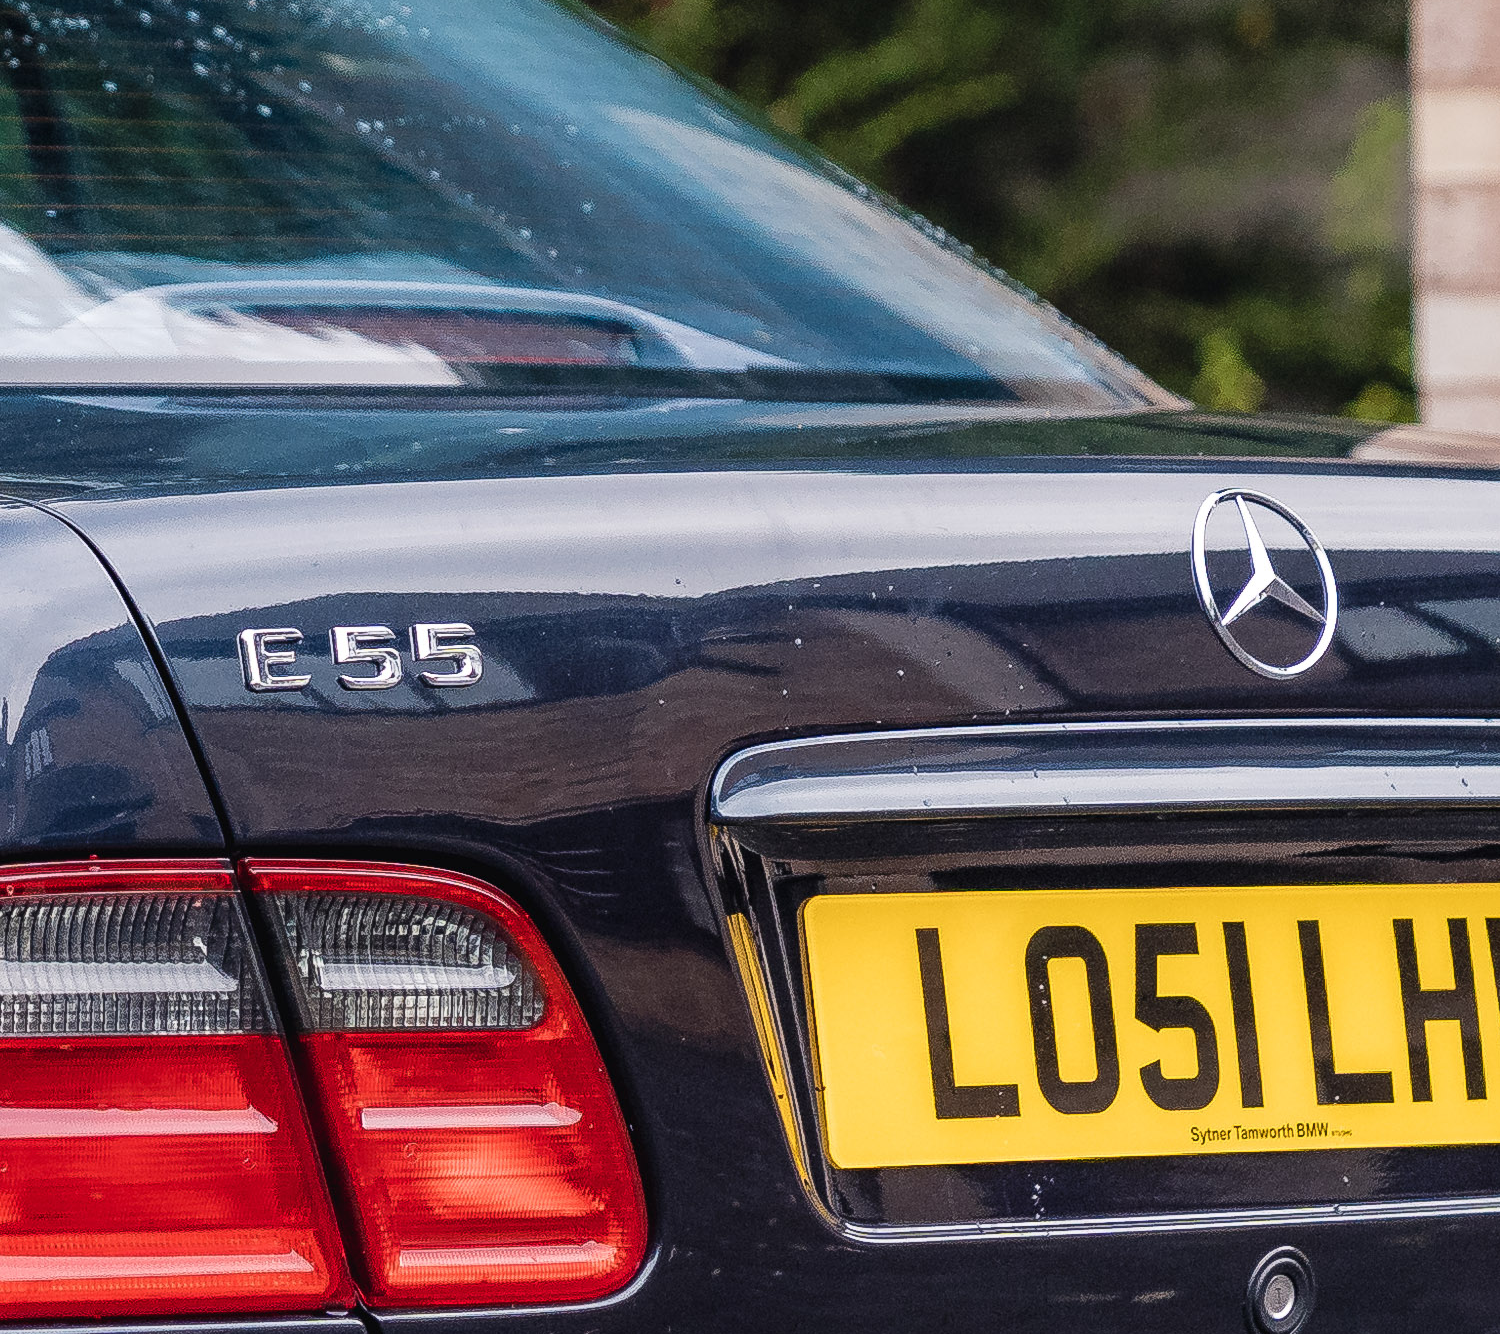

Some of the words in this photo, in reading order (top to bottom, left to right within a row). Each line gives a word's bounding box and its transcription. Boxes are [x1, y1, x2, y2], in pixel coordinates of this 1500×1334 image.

[915, 921, 1264, 1120] LO51
[1190, 1126, 1232, 1146] Sytner
[1233, 1123, 1295, 1140] Tamworth
[1296, 1122, 1329, 1138] BMW
